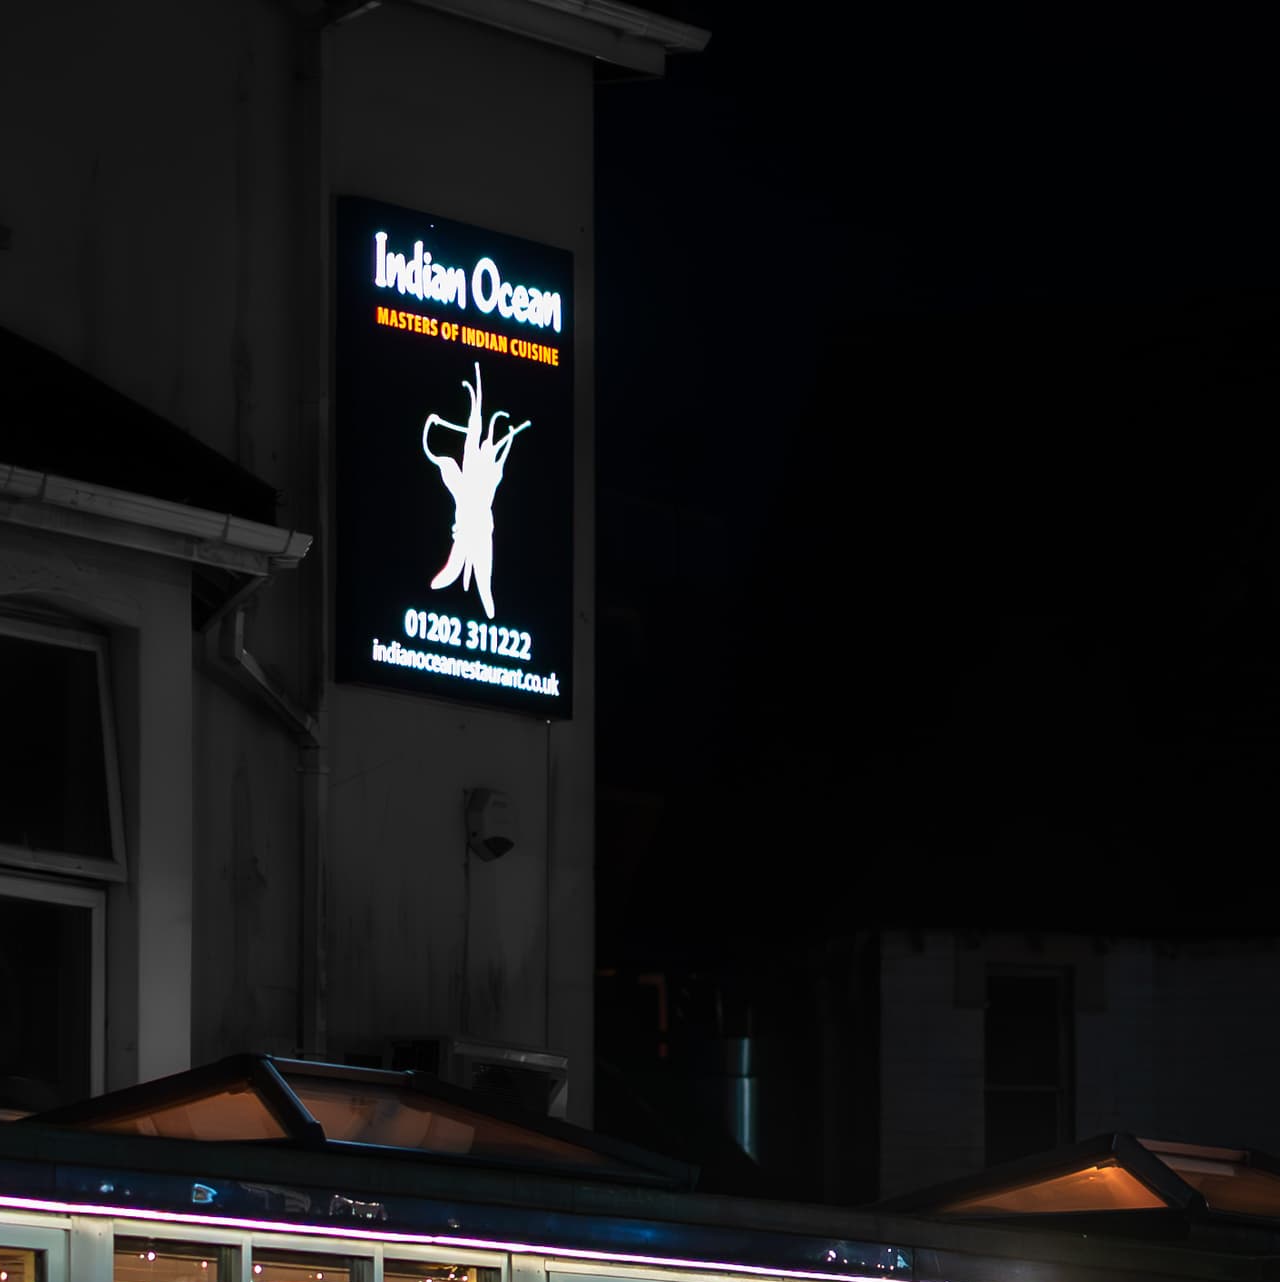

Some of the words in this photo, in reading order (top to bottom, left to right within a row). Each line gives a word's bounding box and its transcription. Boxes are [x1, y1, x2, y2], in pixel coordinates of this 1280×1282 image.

[374, 231, 467, 310] Indian
[471, 257, 562, 333] Ocean
[376, 306, 439, 337] MASTERS
[440, 321, 459, 342] OF
[461, 326, 508, 354] INDIAN
[510, 338, 560, 367] CUISINE
[404, 608, 462, 647] 01202
[465, 620, 532, 661] 311222
[372, 638, 560, 697] indianoceanrestaurant.co.uk
